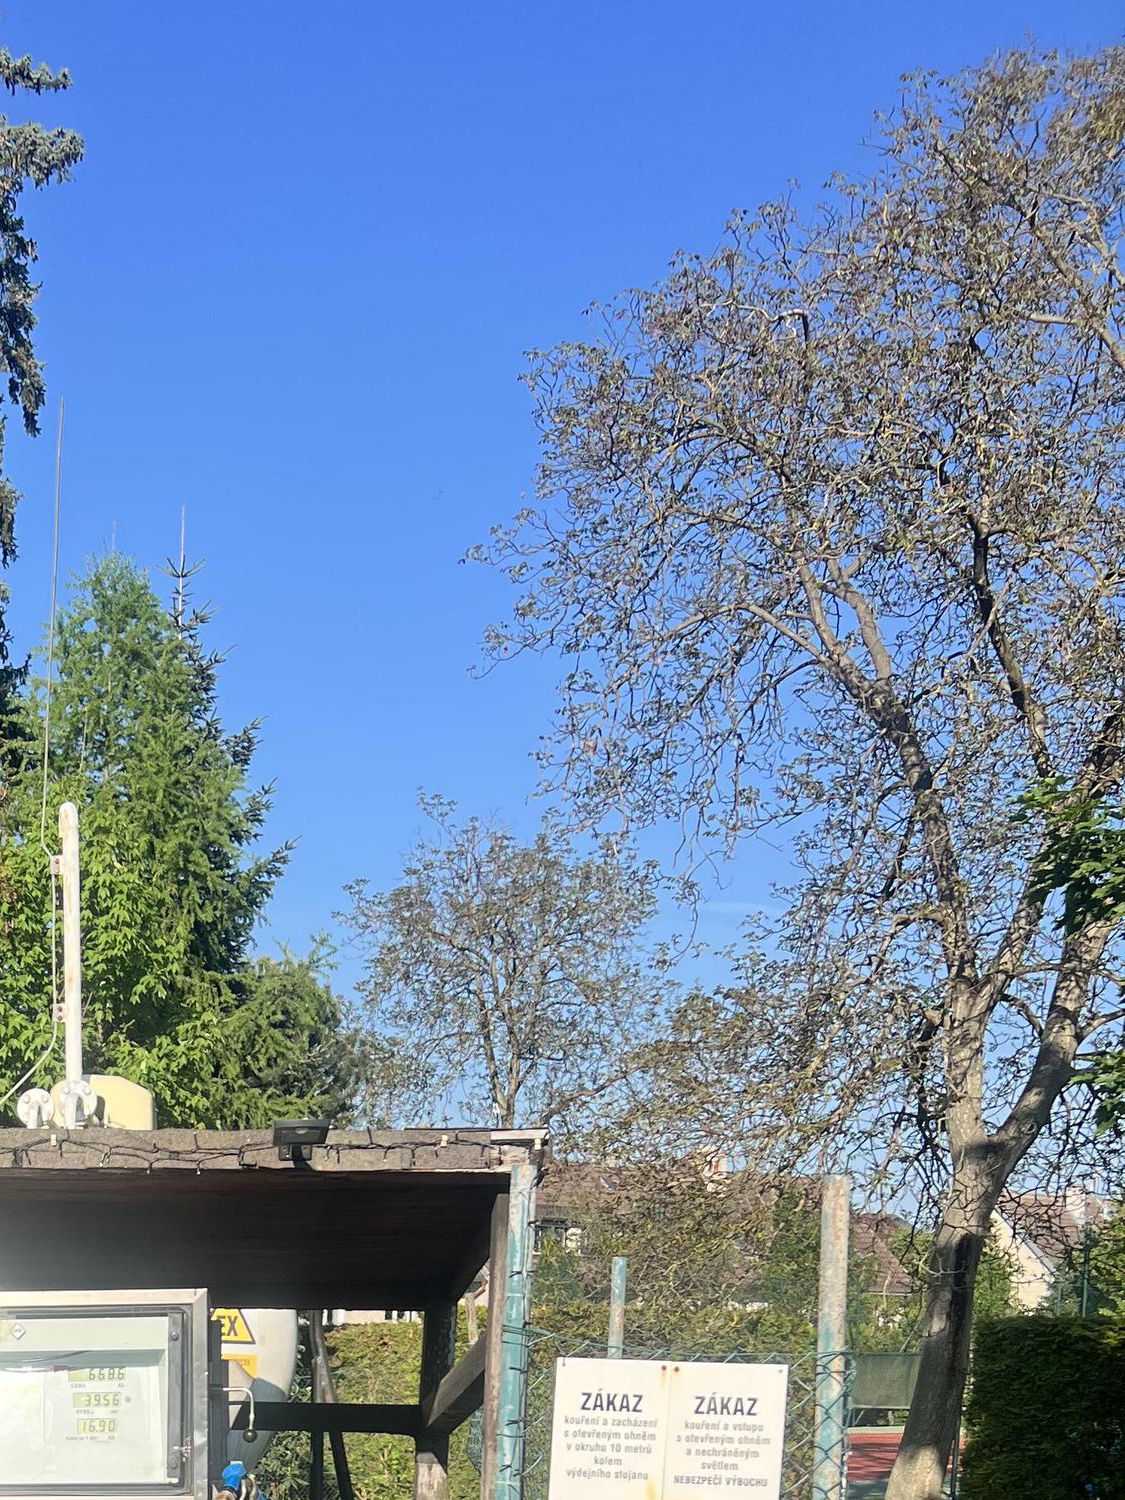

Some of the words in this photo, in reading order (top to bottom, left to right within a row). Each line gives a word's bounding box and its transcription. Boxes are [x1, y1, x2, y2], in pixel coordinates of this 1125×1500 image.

[581, 1388, 643, 1412] ZÁKAZ
[695, 1392, 757, 1416] ZÁKAZ
[564, 1416, 599, 1425] kouření
[603, 1418, 607, 1426] a
[611, 1418, 659, 1428] zacházení
[685, 1420, 721, 1430] kouření
[573, 1429, 620, 1441] otevřeným
[624, 1431, 656, 1440] ohněm
[685, 1433, 734, 1445] otevřeným
[738, 1435, 770, 1445] ohněm
[575, 1443, 606, 1452] okruhu
[611, 1444, 621, 1452] 10
[625, 1444, 652, 1453] metrů
[686, 1448, 691, 1456] a
[695, 1448, 759, 1459] nechráněným
[594, 1456, 622, 1465] kolem
[701, 1461, 738, 1470] světlem
[567, 1468, 610, 1479] výdejního
[615, 1470, 648, 1480] stojanu
[674, 1475, 722, 1485] NEBEZPEČÍ
[725, 1475, 767, 1486] VÝBUCHU
